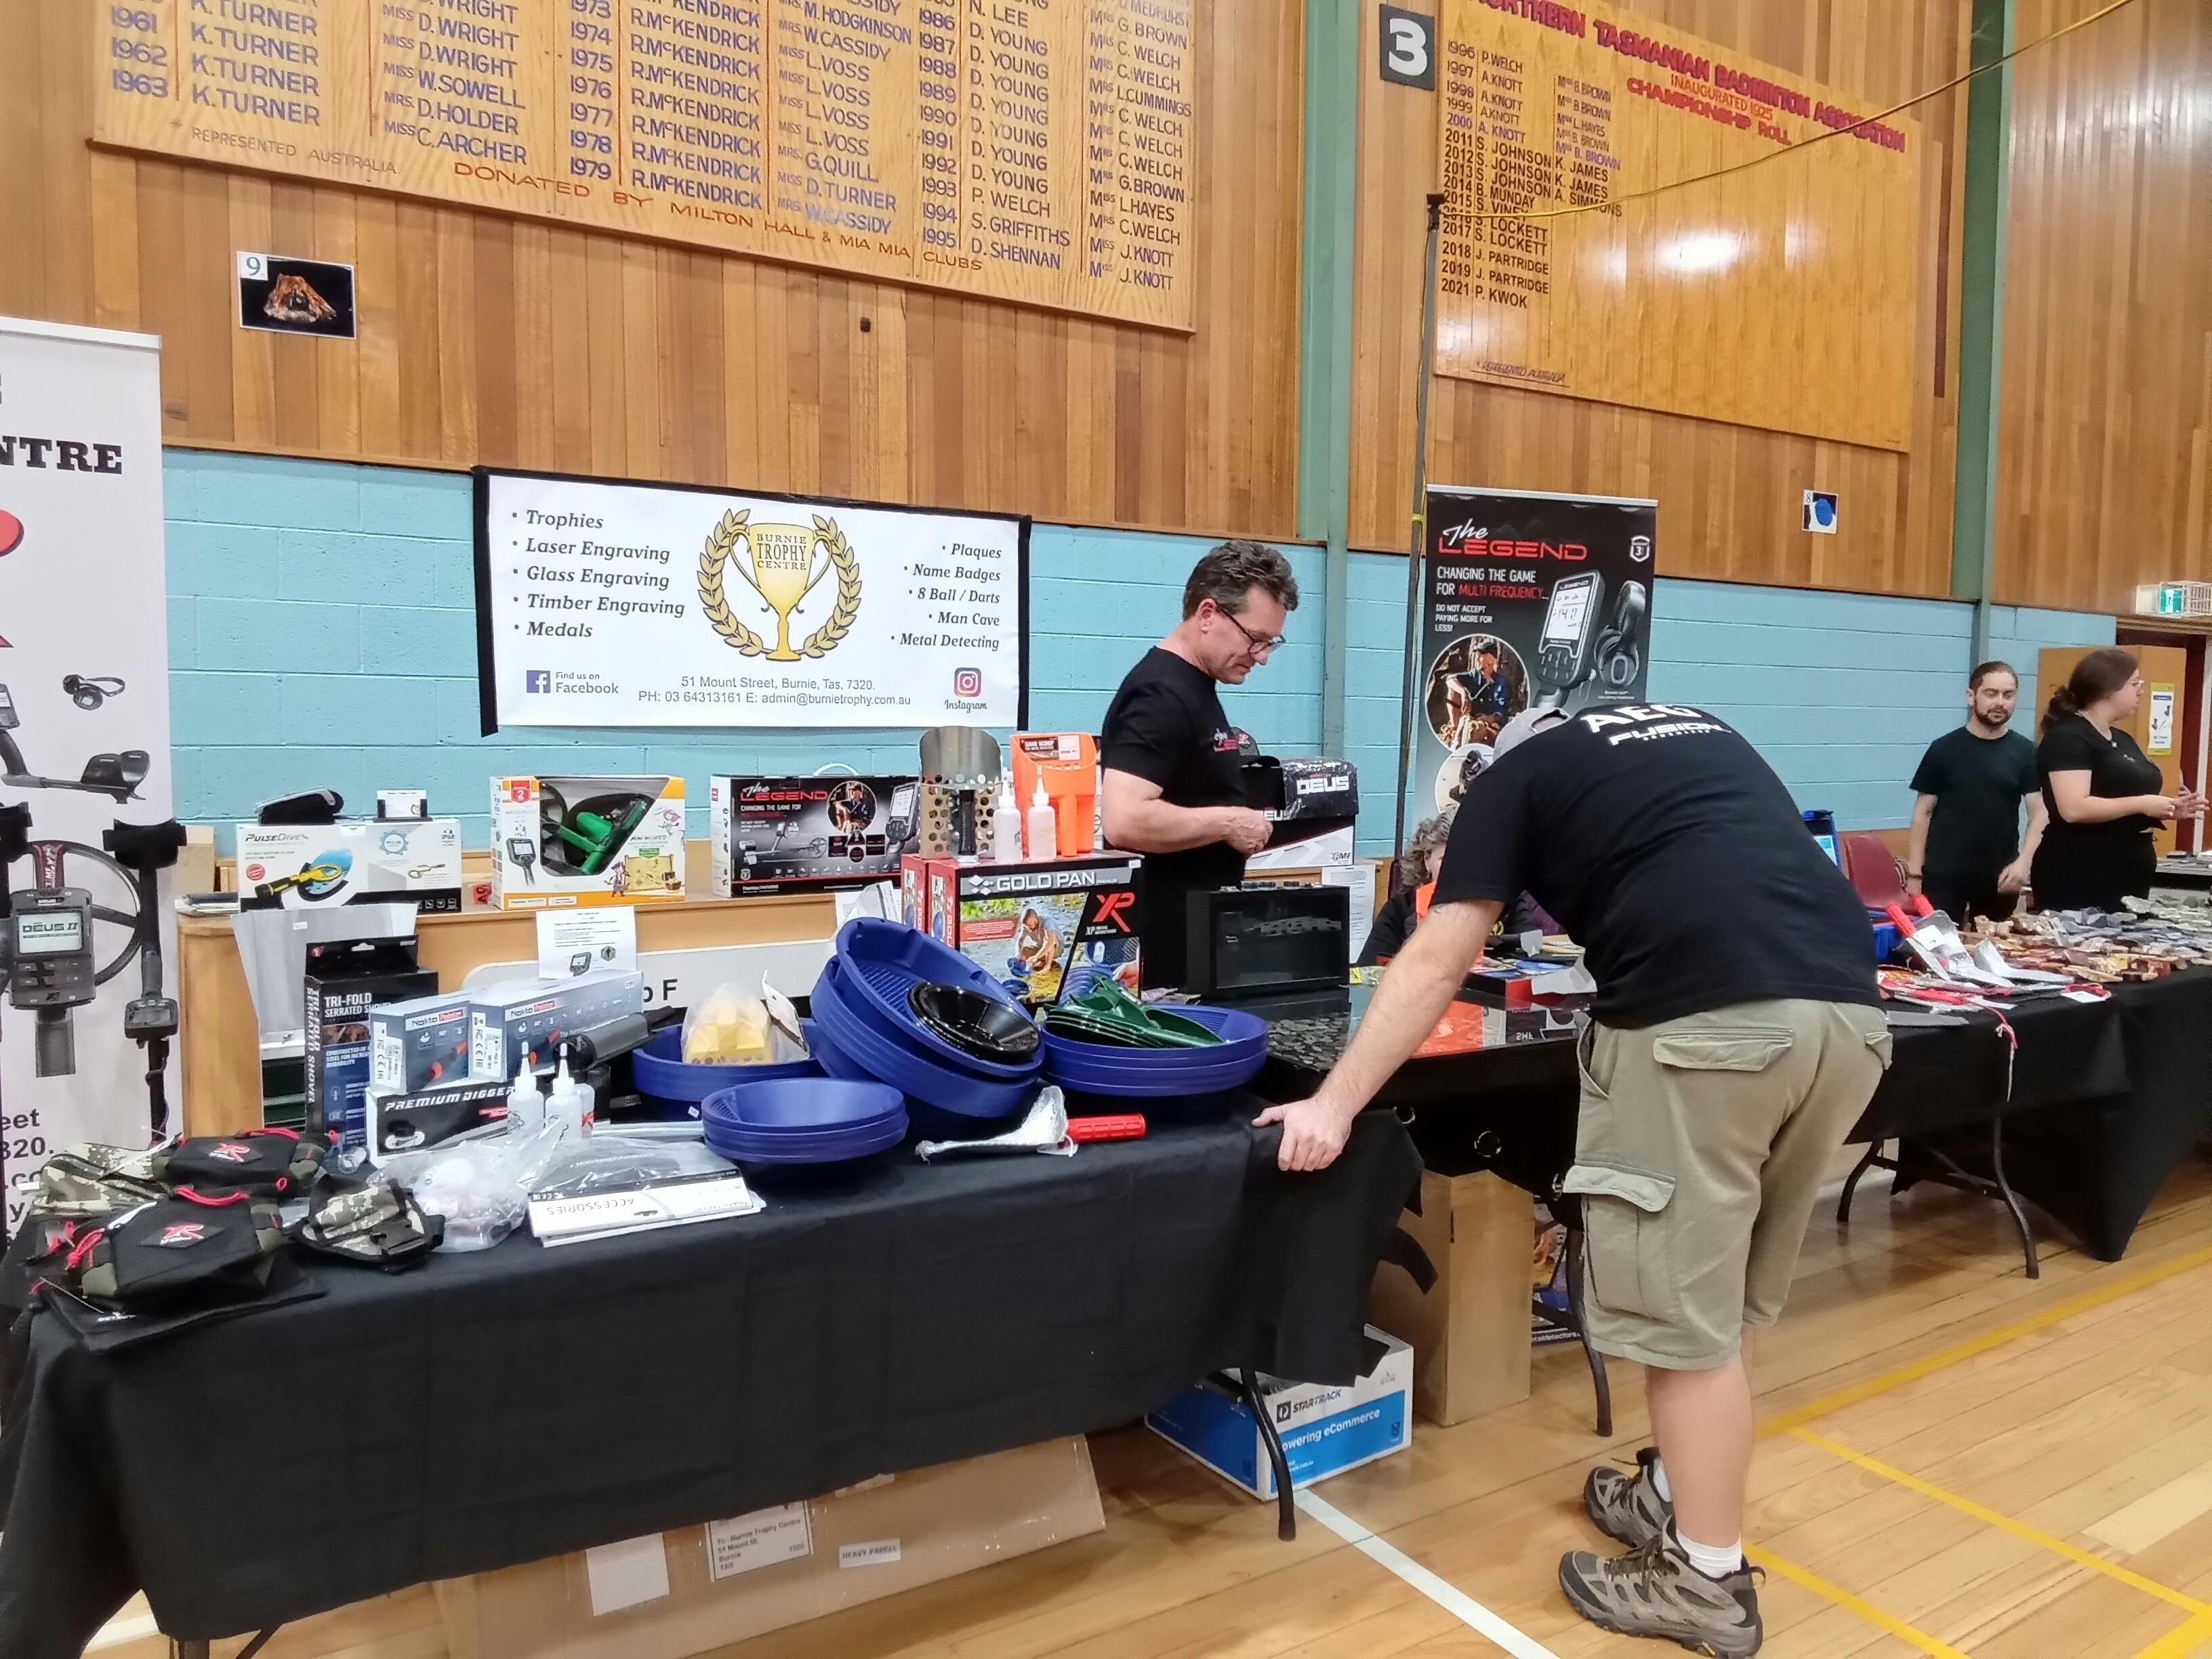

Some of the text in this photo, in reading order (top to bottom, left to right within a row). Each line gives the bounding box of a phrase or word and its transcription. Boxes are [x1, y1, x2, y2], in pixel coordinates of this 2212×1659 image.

[111, 6, 157, 34] 1961
[992, 7, 1029, 28] LEE
[571, 20, 612, 45] 1974
[111, 36, 168, 66] 1962
[1388, 18, 1428, 76] 3
[571, 47, 613, 73] 1975
[1447, 61, 1474, 79] 1997
[1593, 19, 1711, 82] TASMANIAN
[1715, 64, 1810, 119] BADMINTON
[112, 68, 169, 98] 1963
[571, 75, 612, 99] 1976
[1671, 74, 1773, 121] INAUGURATED 1925
[1626, 77, 1792, 146] CHAMPIONSHIP ROLL
[191, 127, 297, 157] REPRESENTED
[1446, 129, 1608, 182] 2011 JOHNSON JAMES
[571, 157, 612, 180] 1979
[922, 153, 1048, 194] 1992 YOUNG
[922, 177, 1050, 218] 1993 WELCH
[1443, 175, 1536, 209] 2014 MUNDAY
[454, 162, 982, 270] DONATED BY MILTON HALL & MIA MIA CLUBS
[923, 202, 958, 224] 1994
[923, 227, 956, 248] 1995
[1443, 220, 1547, 256] 2017 LOCKETT
[246, 257, 261, 276] 9
[1442, 241, 1549, 275] 2018 PARTRIDGE
[1441, 278, 1528, 309] 2021 KWOK
[527, 509, 604, 530] Trophies
[757, 533, 806, 545] BURNIE
[1443, 518, 1488, 546] The
[526, 537, 670, 565] Laser Engraving
[757, 543, 806, 562] TROPHY
[951, 543, 1002, 559] Plaques
[1439, 536, 1587, 560] LEGEND
[757, 560, 806, 571] CENTRE
[912, 563, 1001, 582] Name Badges
[1437, 566, 1536, 583] CHANGING THE GAME
[527, 566, 670, 591] Glass Engraving
[1436, 582, 1456, 596] FOR
[1459, 583, 1487, 596] MULTI
[528, 593, 685, 618] Timber Engraving
[918, 588, 1000, 604] 8 Ball Darts
[527, 621, 593, 638] Medals
[937, 611, 1000, 627] Man Cave
[900, 633, 1000, 652] Metal Detecting
[556, 672, 575, 680] Find
[682, 676, 695, 687] 51
[700, 676, 737, 689] Mount
[740, 677, 778, 691] Street,
[782, 678, 819, 690] Burnie,
[847, 679, 876, 691] 7320.
[555, 682, 619, 694] Facebook
[638, 691, 911, 707] PH: 03 64313161 E: admin@burnietrophy.com.au
[944, 699, 987, 713] Instagram
[1580, 704, 1702, 733] AEG
[741, 791, 827, 801] LEGEND
[1296, 775, 1349, 794] DEUS
[996, 871, 1095, 890] GOLD PAN
[324, 993, 372, 1008] TRI-FOLD
[325, 1006, 363, 1017] SERRATED
[386, 1086, 516, 1111] PREMIUM DIGGER
[546, 1198, 634, 1214] ACCESSORIES
[1292, 1389, 1342, 1413] STARTRACK
[1324, 1409, 1380, 1436] eCommerce
